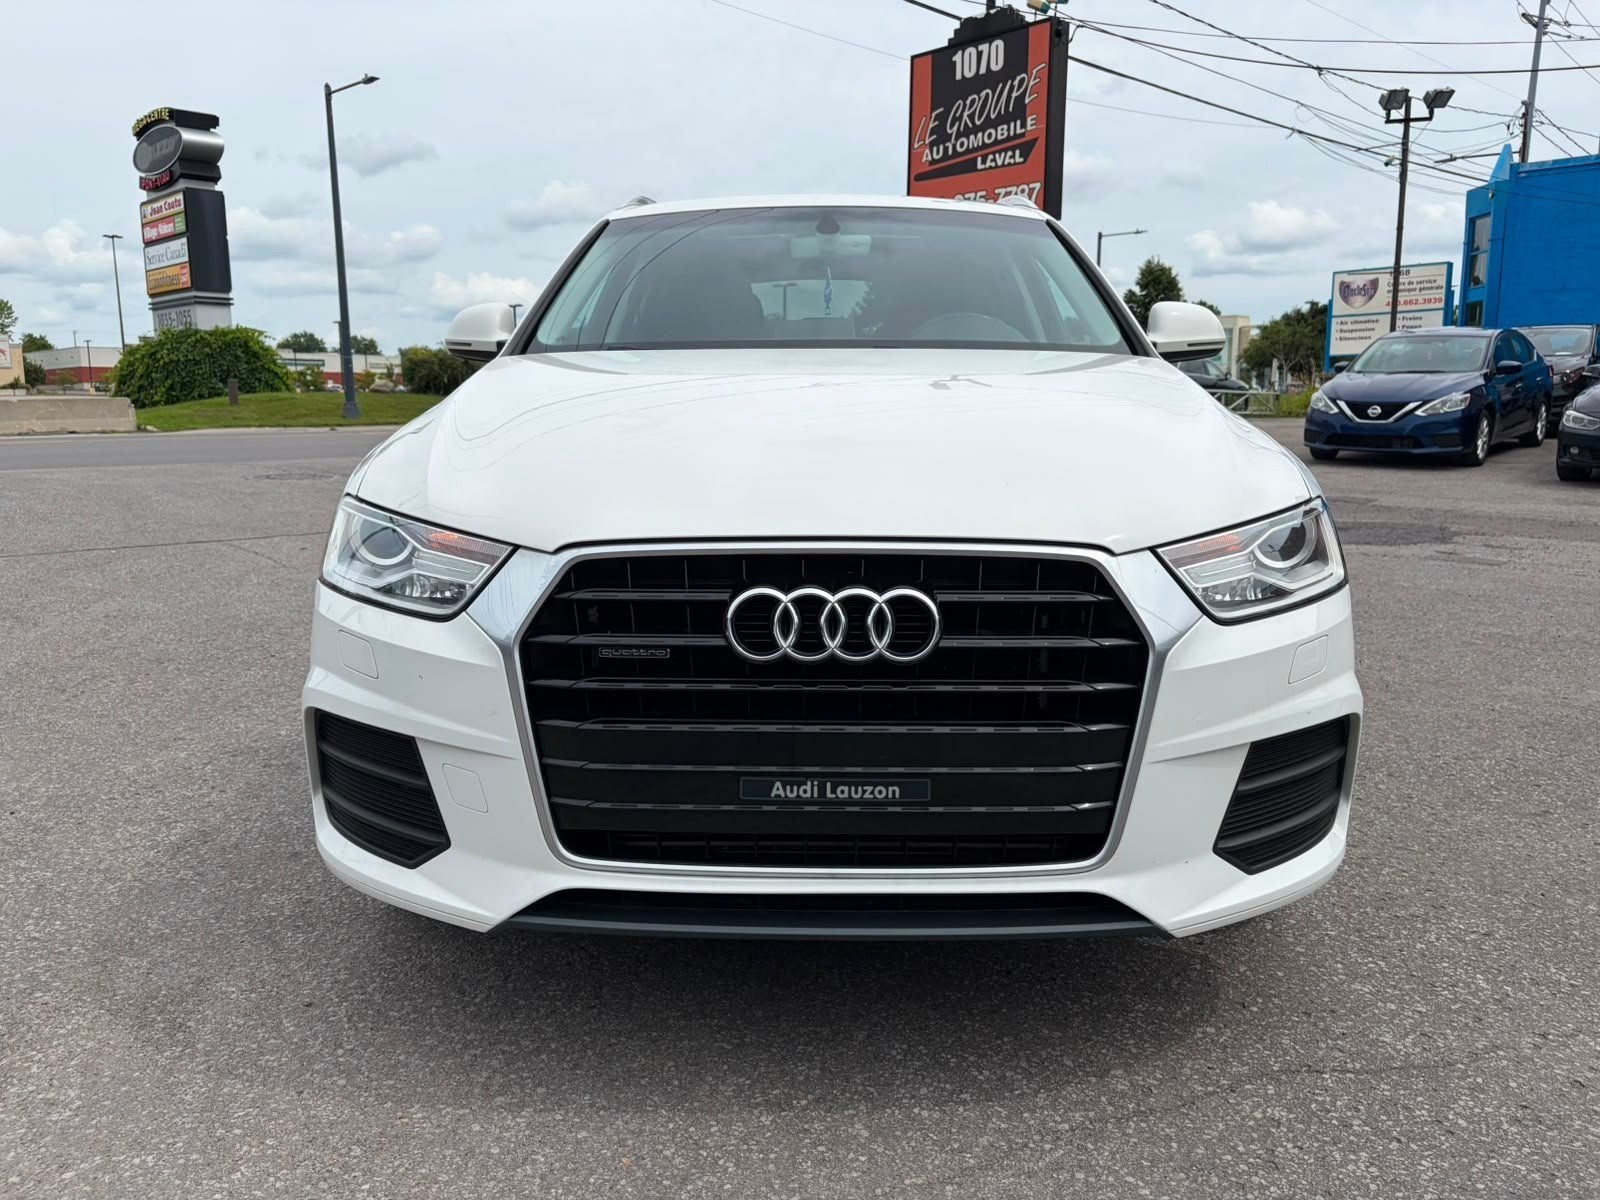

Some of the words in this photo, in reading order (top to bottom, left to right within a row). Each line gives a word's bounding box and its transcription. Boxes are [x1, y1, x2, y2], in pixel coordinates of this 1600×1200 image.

[952, 39, 1005, 81] 1070
[914, 107, 944, 149] LE
[946, 63, 1046, 144] GROUPE
[922, 115, 1037, 163] AUTOMOBILE
[976, 149, 1024, 170] LAVAL
[149, 204, 164, 217] Jean
[146, 250, 165, 265] Service
[165, 246, 187, 261] Canada
[1386, 297, 1443, 307] 40.662.3939
[601, 648, 666, 657] quattro
[770, 780, 819, 798] Audi
[825, 781, 901, 799] Lauzon
